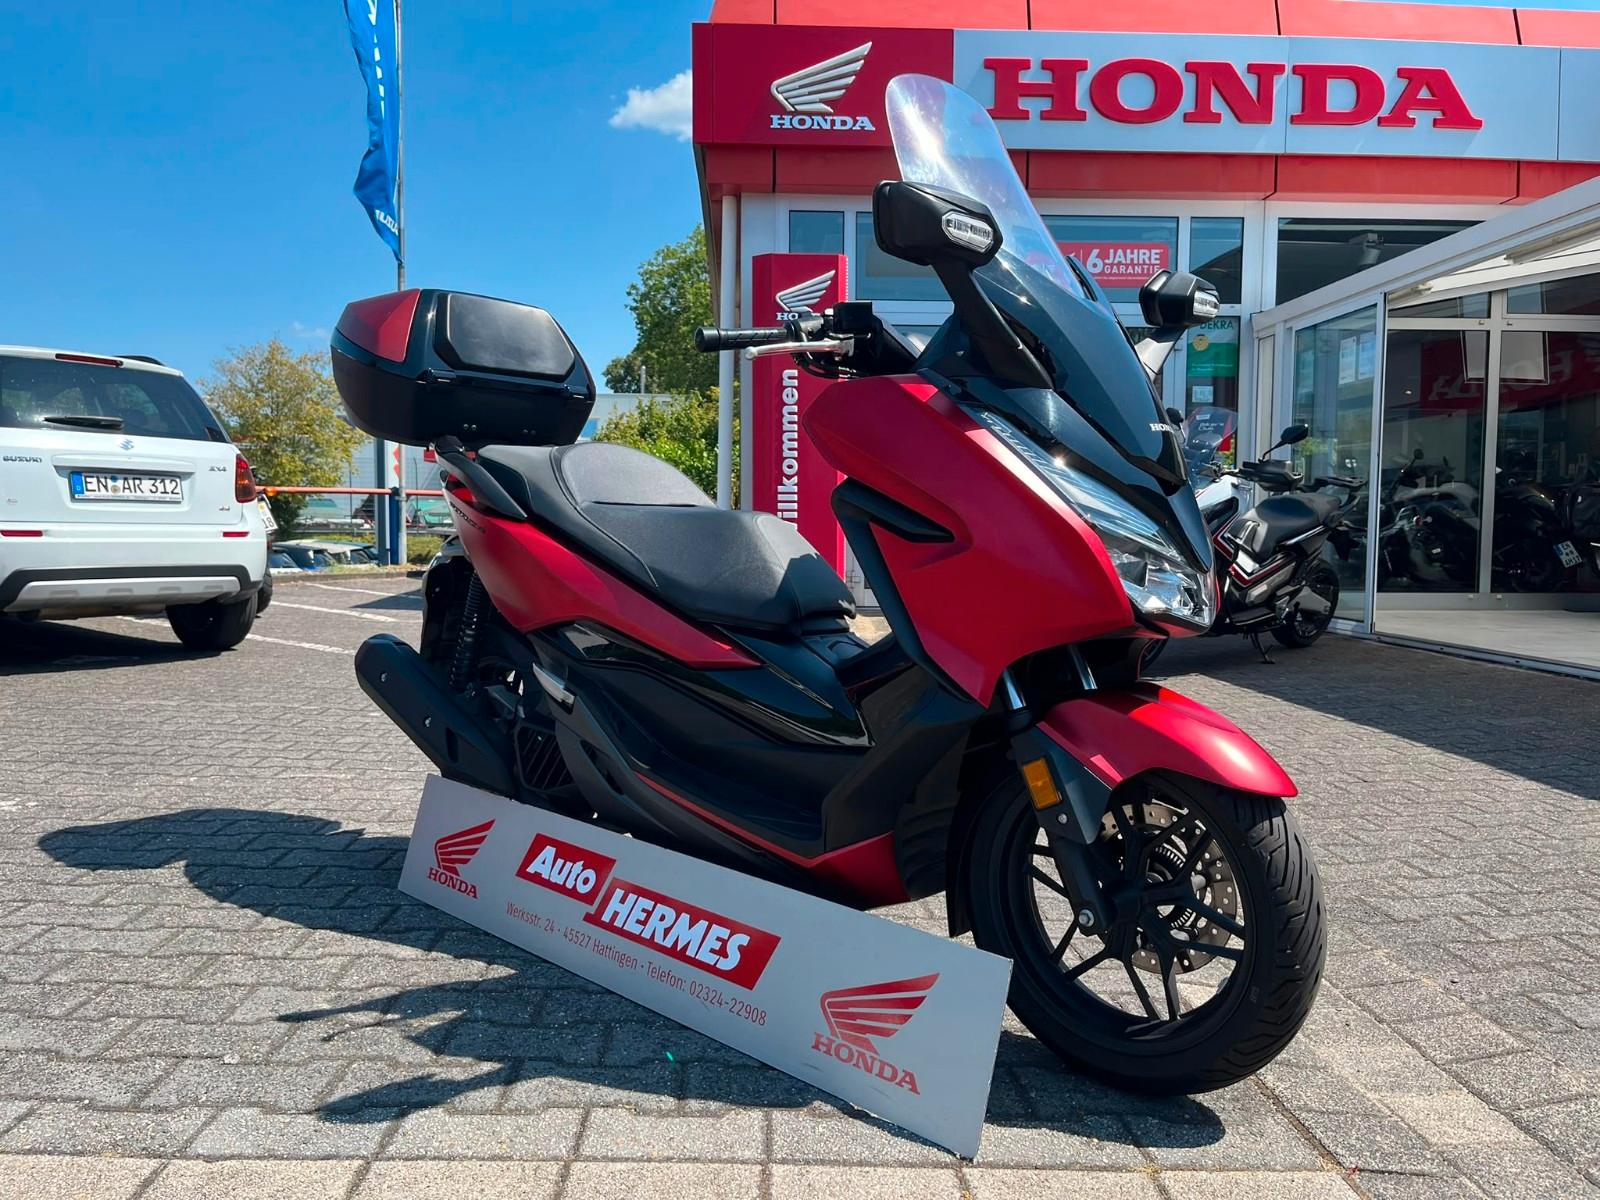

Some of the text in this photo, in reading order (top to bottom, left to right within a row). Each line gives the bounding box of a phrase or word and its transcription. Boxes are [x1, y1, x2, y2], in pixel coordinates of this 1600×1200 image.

[983, 57, 1483, 130] HONDA
[770, 114, 876, 131] HONDA
[1086, 249, 1104, 274] 6
[777, 369, 798, 530] illkommen
[85, 475, 180, 495] EN AR 312
[427, 867, 479, 899] HONDA
[526, 845, 597, 895] Auto
[601, 888, 750, 971] HERMES
[506, 902, 767, 1027] Werksstr. 24 45527 Hattingen Telefon: 02324-22908
[811, 1032, 921, 1096] HONDA
